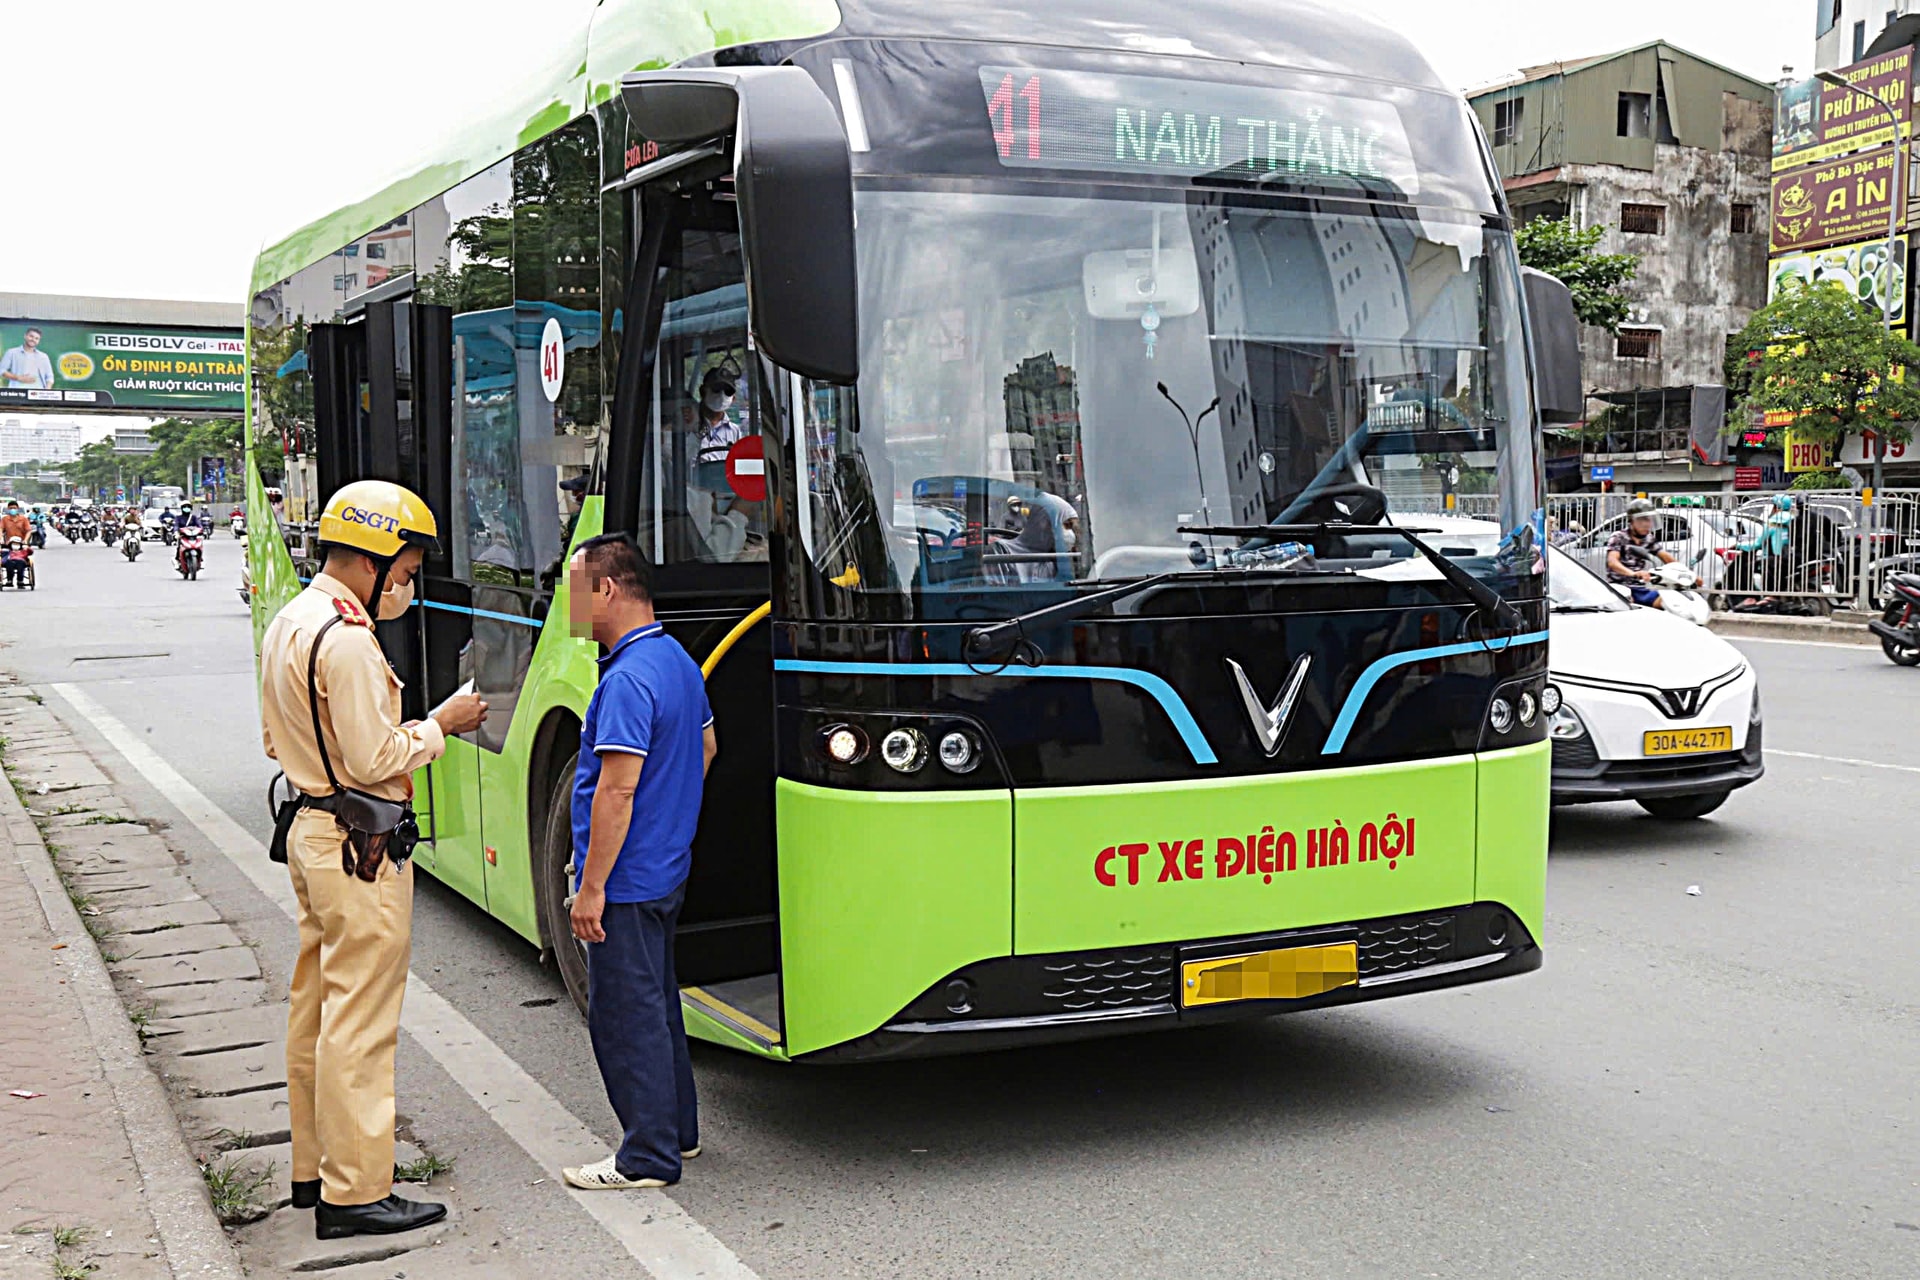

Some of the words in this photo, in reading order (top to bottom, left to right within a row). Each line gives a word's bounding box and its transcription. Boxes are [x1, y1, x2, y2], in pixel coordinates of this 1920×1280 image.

[1895, 54, 1908, 71] TẠO
[1824, 91, 1852, 121] PHỞ
[1856, 86, 1875, 112] HÀ
[1878, 79, 1905, 105] NỘI
[1115, 107, 1220, 166] NAM
[1237, 108, 1383, 177] THĂNG
[1815, 168, 1836, 184] Phở
[1837, 165, 1851, 178] Bò
[1854, 161, 1874, 175] Đặc
[1876, 154, 1894, 169] Biệ
[1825, 187, 1846, 214] A
[95, 335, 184, 350] REDISOLV
[187, 341, 206, 351] Gel
[102, 354, 130, 372] ỔN
[131, 359, 172, 375] ĐỊNH
[175, 361, 204, 377] ĐẠI
[206, 361, 245, 376] TRÀN
[544, 341, 558, 382] 41
[113, 378, 147, 390] GIẢM
[149, 379, 182, 392] RUỘT
[184, 379, 213, 391] KÍCH
[341, 506, 399, 533] CSGT
[1652, 731, 1725, 751] 30A-442.77
[1094, 843, 1149, 887] CT
[1157, 839, 1203, 883] XE
[1215, 825, 1296, 885] ĐIỆN
[1307, 819, 1348, 869] HÀ
[1358, 812, 1416, 871] NỘI
